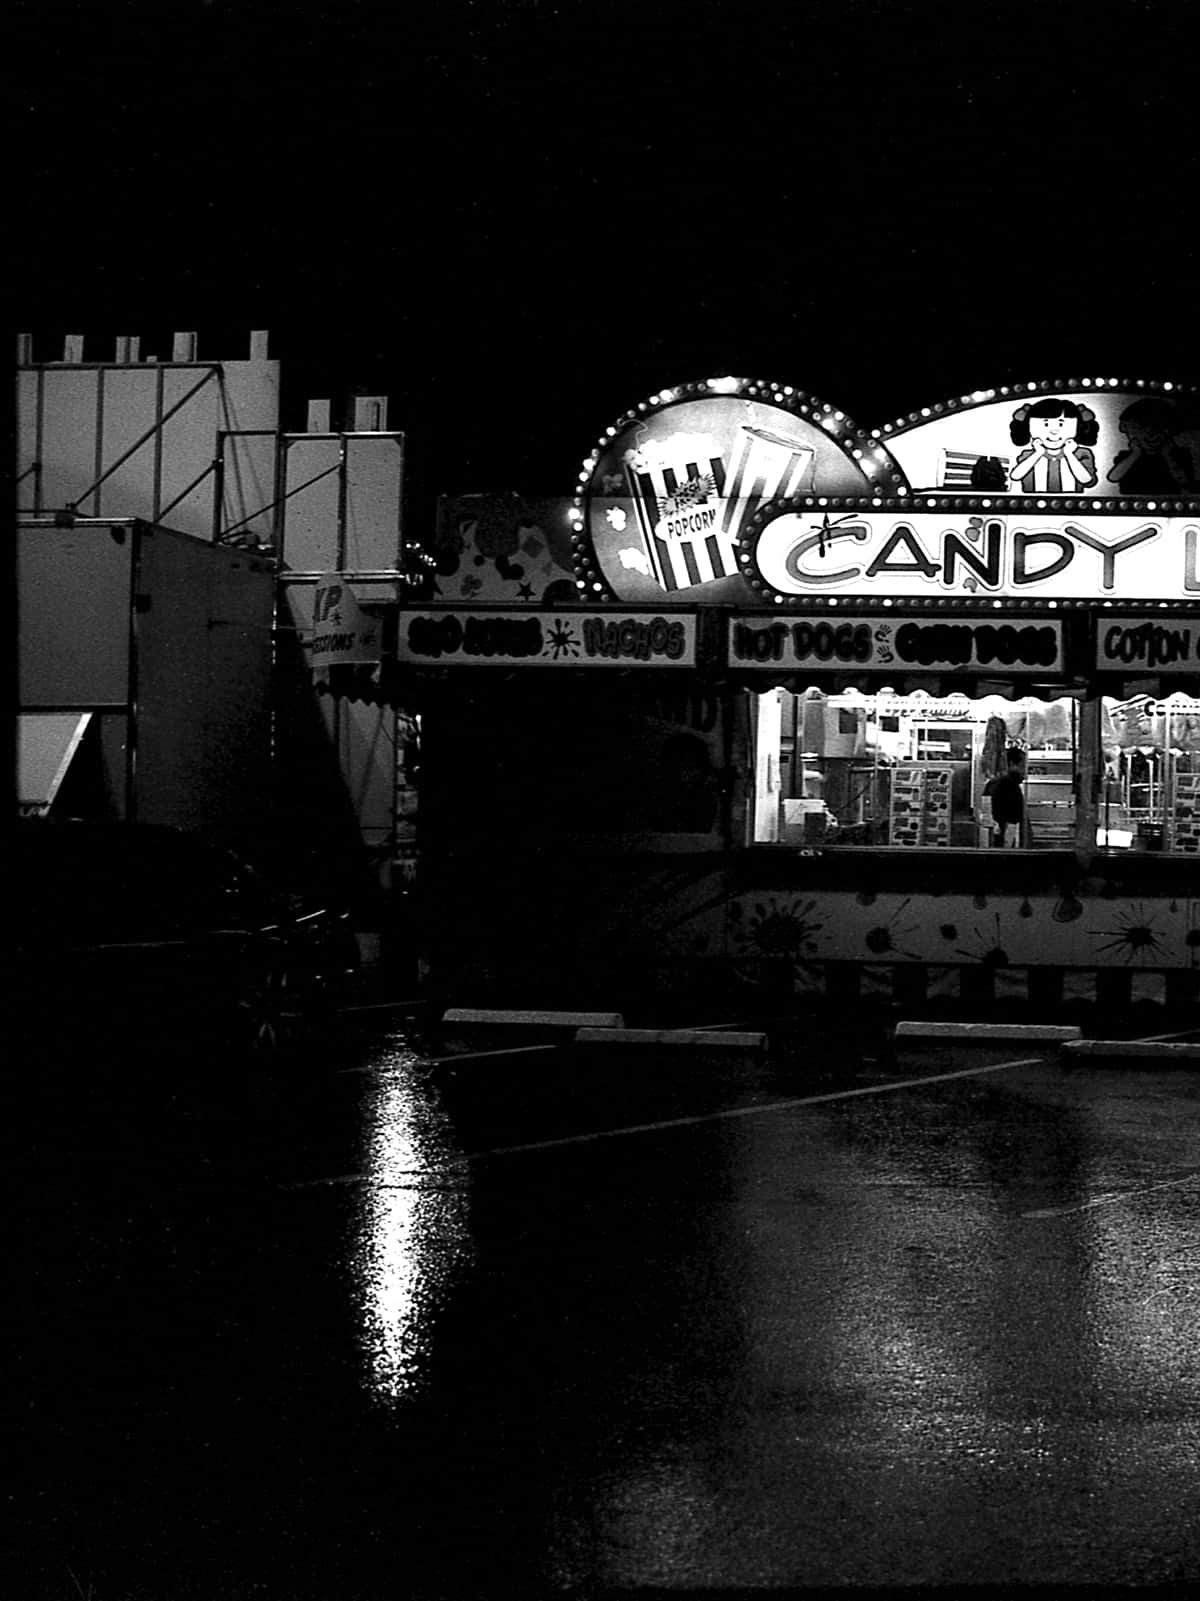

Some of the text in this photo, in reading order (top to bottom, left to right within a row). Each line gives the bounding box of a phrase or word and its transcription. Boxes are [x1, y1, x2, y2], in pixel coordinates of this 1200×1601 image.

[667, 508, 717, 540] POPCORN
[785, 517, 1160, 593] CANDY
[583, 617, 685, 660] NACHOS
[733, 622, 789, 661] HOT
[791, 622, 873, 662] DOGS
[1104, 623, 1190, 667] COTTON
